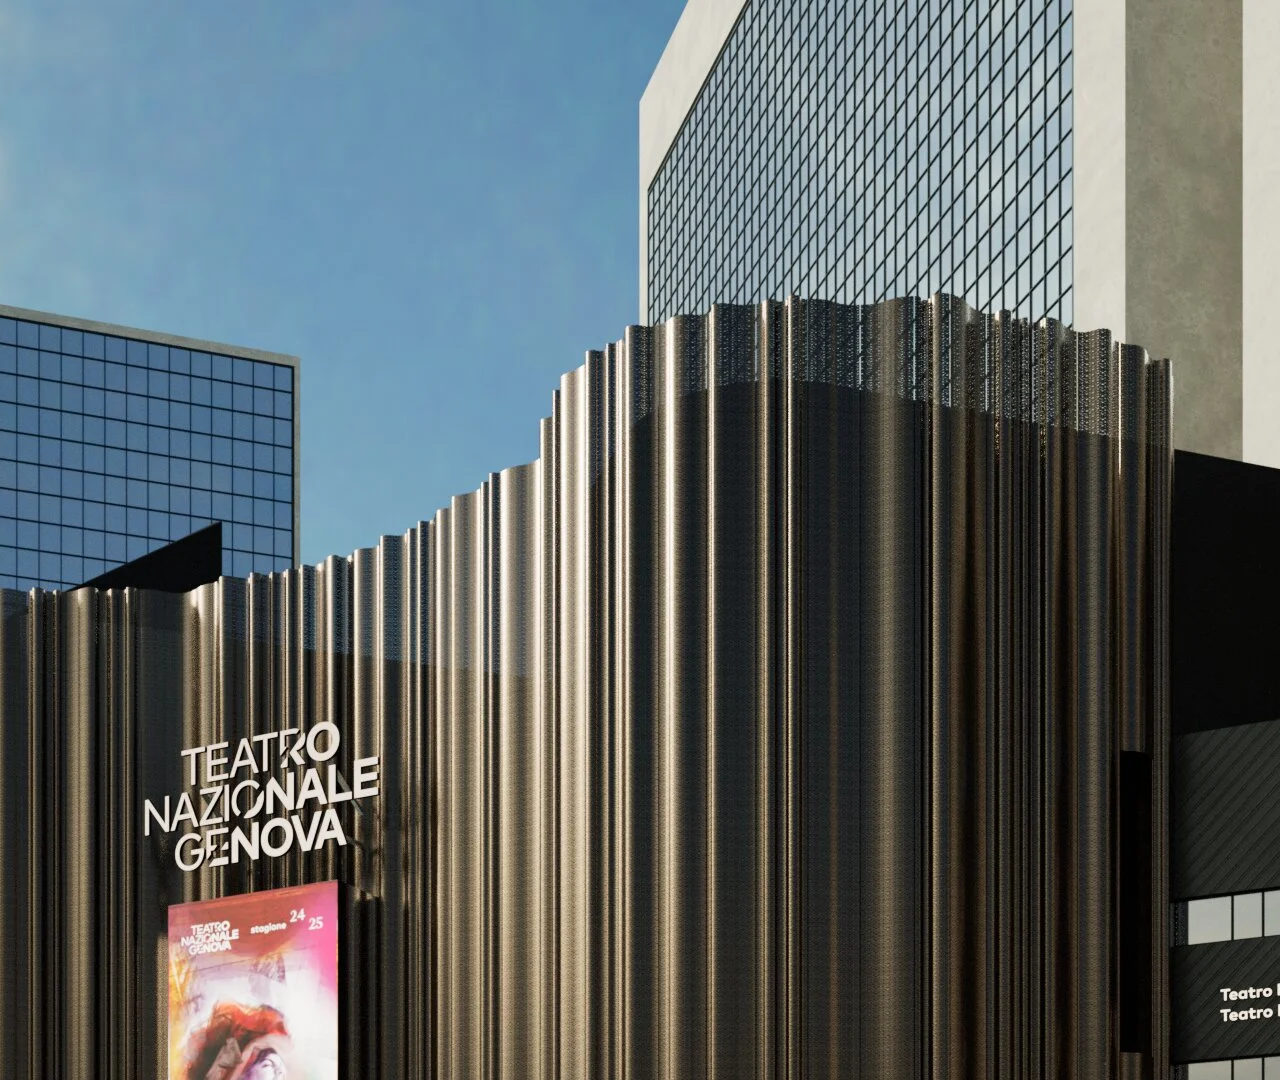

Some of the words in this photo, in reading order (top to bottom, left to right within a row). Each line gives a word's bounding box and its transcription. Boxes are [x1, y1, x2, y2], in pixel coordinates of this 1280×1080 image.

[181, 721, 340, 785] TEATRO
[144, 757, 379, 836] NAZIONALE
[174, 809, 348, 871] GENOVA
[190, 921, 231, 935] TEATRO
[250, 922, 287, 934] stagione
[290, 908, 306, 923] 24
[308, 916, 324, 930] 25
[181, 929, 239, 946] NAZIONALE
[189, 941, 232, 955] GENOVA
[1220, 987, 1273, 1001] Teatro
[1220, 1007, 1273, 1022] Teatro
